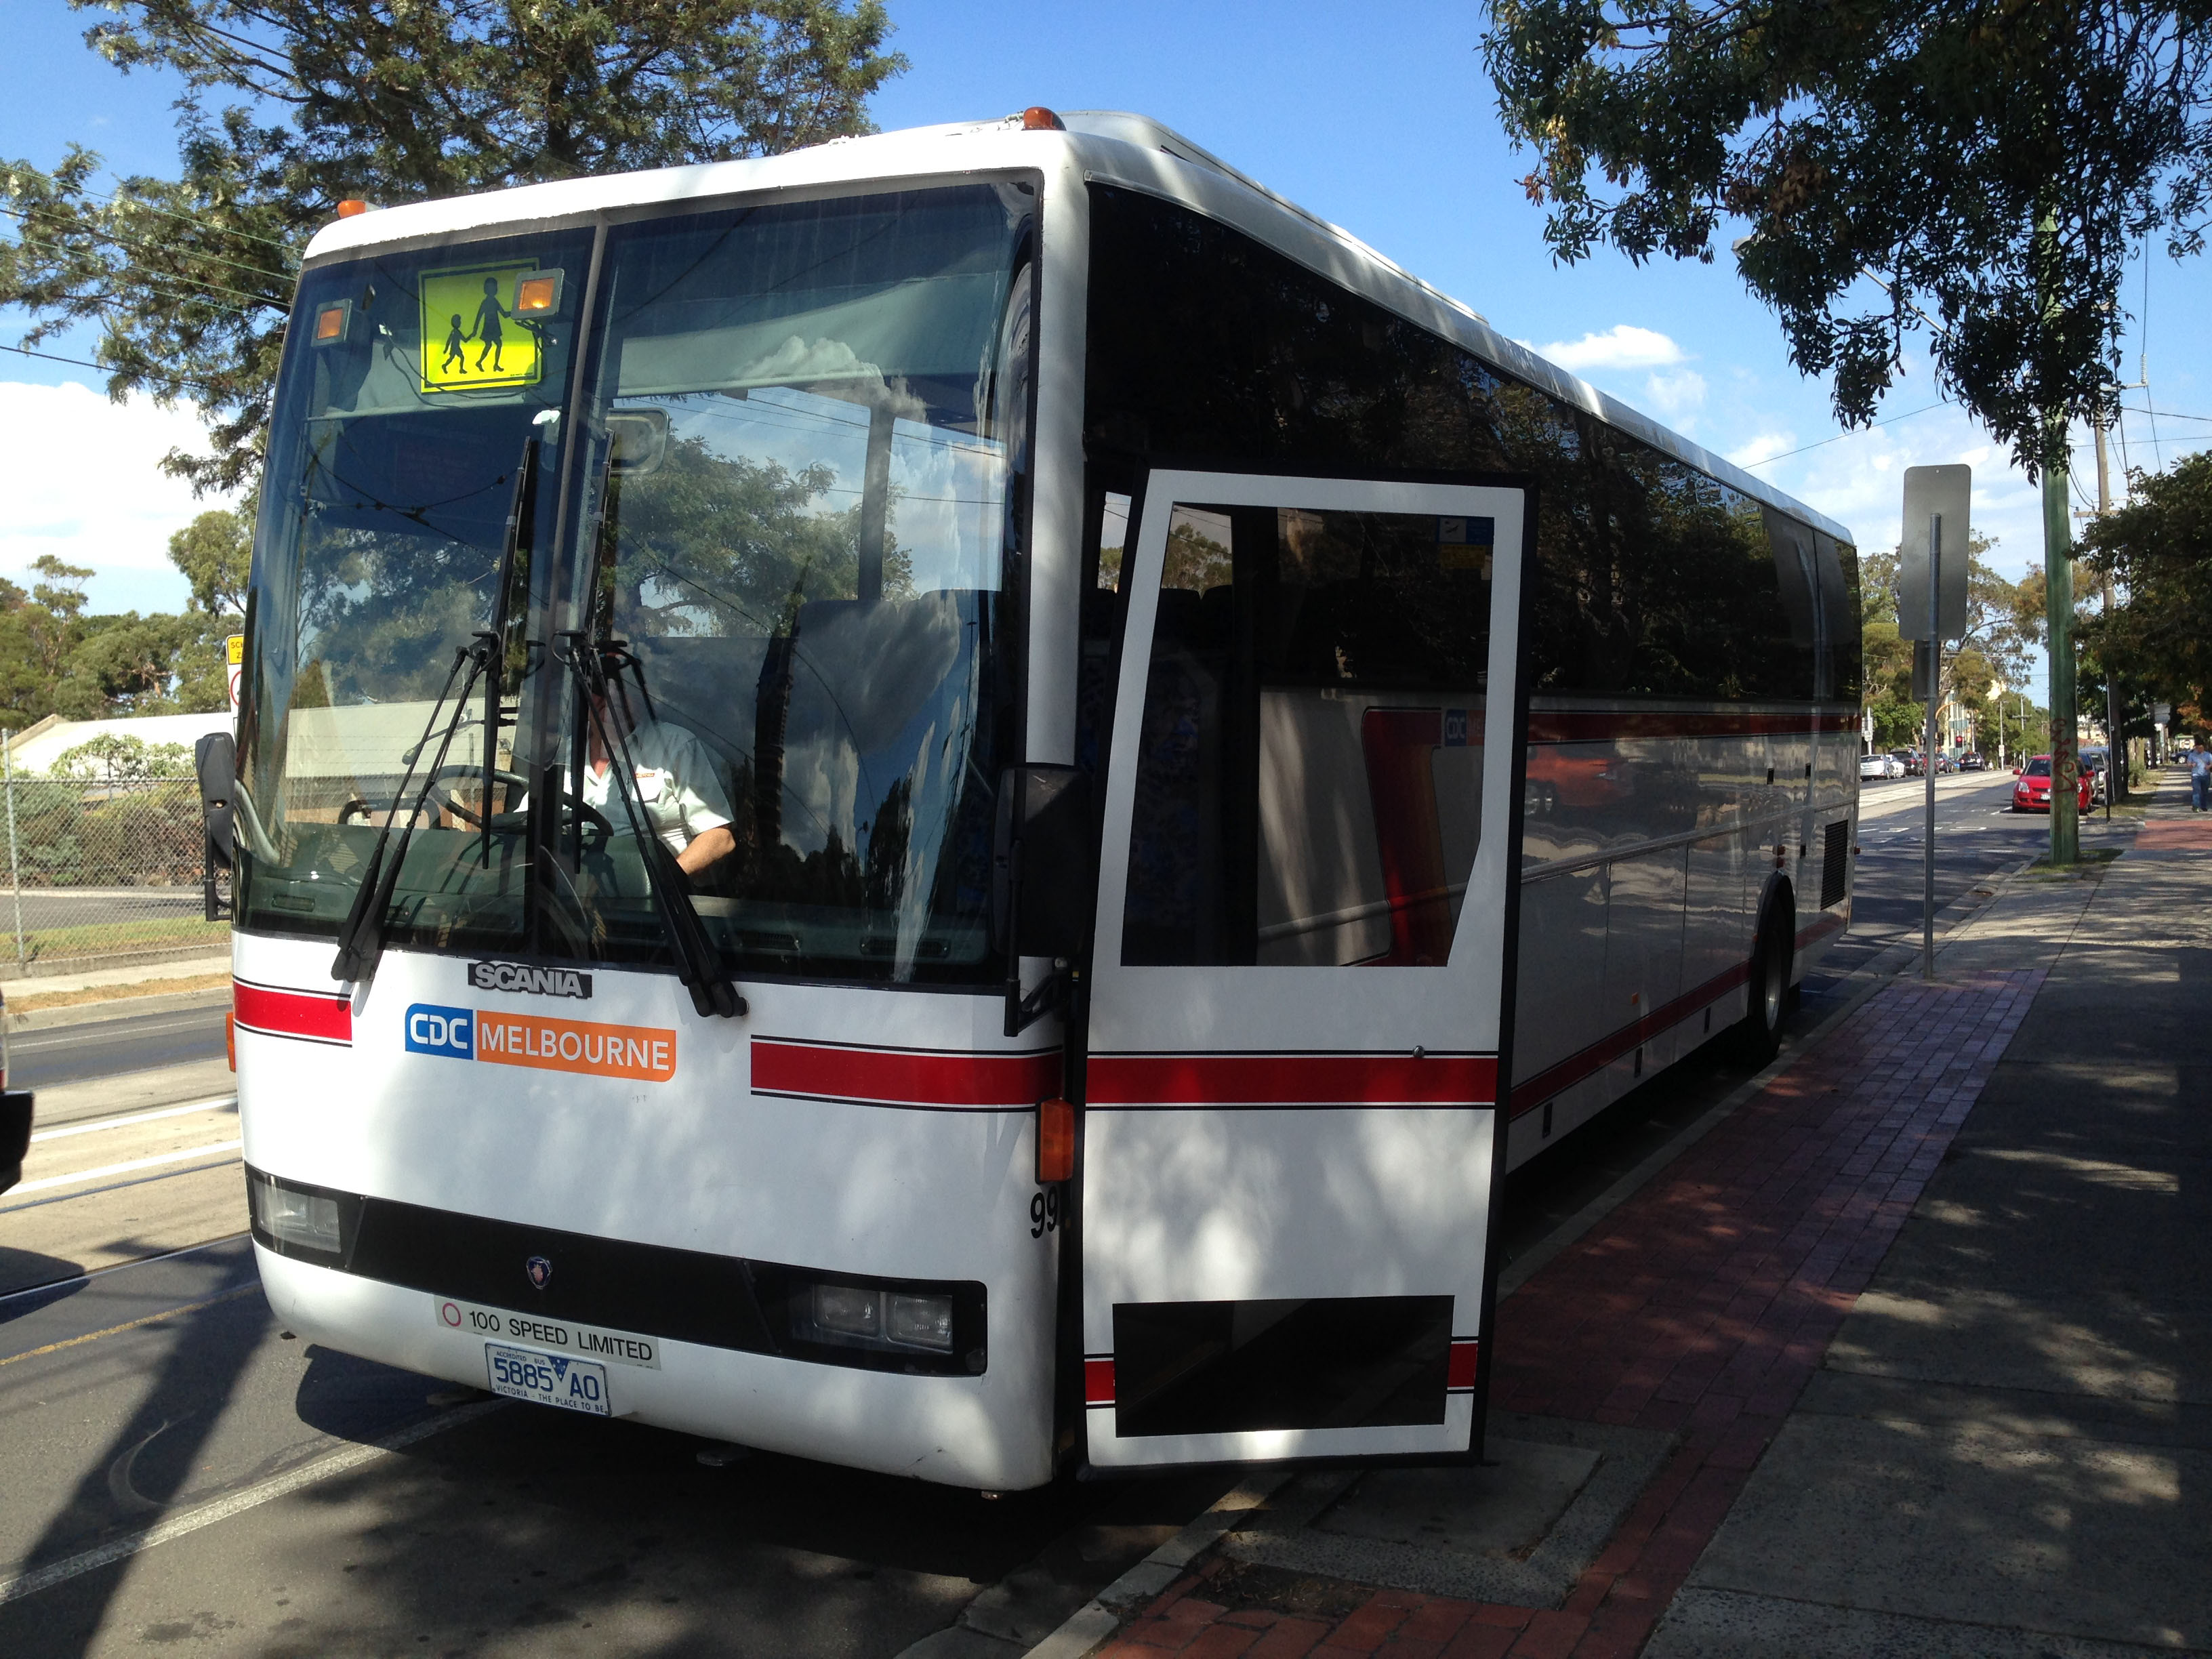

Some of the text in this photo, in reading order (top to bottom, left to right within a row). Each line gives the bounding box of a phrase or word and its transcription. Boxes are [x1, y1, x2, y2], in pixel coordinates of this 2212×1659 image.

[1447, 716, 1466, 740] CDC
[474, 962, 584, 998] SCANIA
[410, 1012, 670, 1071] CDC MELBOURNE
[1030, 1185, 1058, 1239] 99
[469, 1311, 653, 1361] 100 SPEED LIMITED
[496, 1350, 527, 1361] ACCREDITED
[494, 1357, 600, 1401] 5885 AO
[496, 1384, 529, 1398] VICTORIA
[538, 1393, 552, 1404] THE
[555, 1396, 577, 1409] PLACE
[581, 1401, 591, 1411] TO
[595, 1404, 605, 1414] BE
